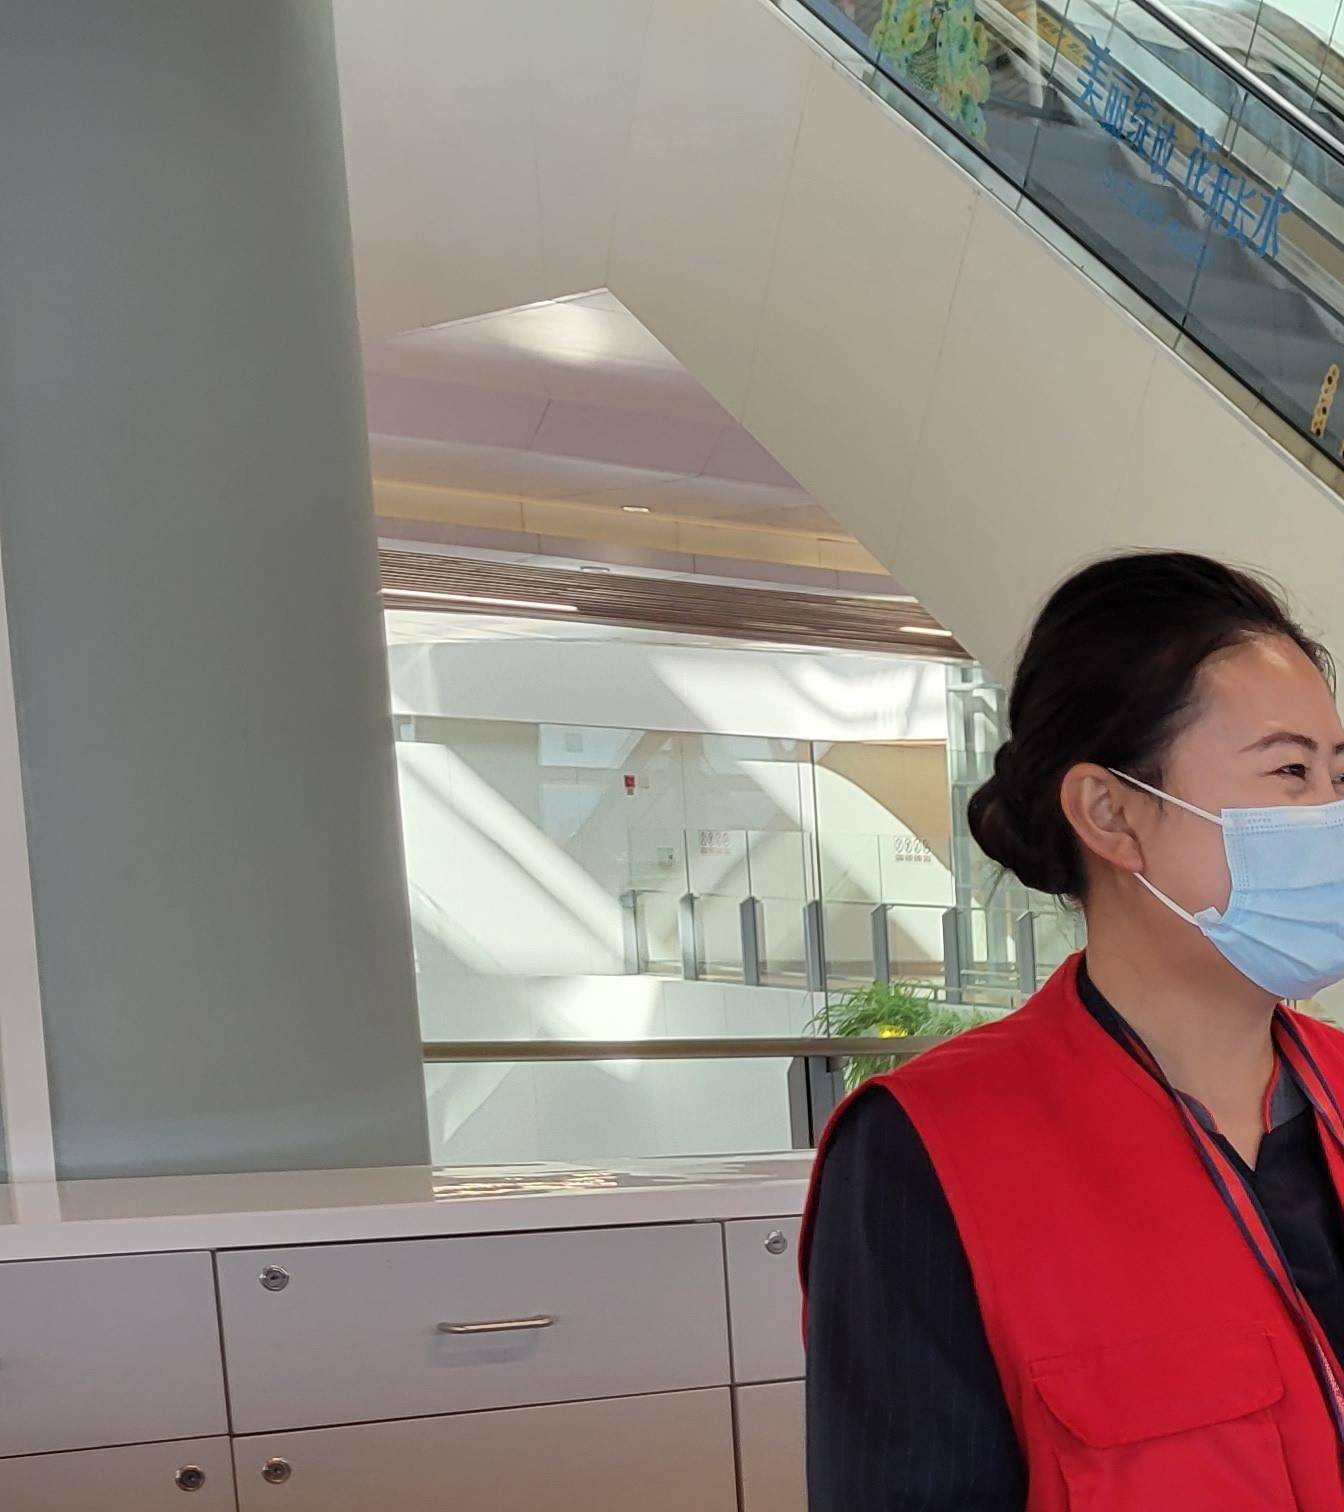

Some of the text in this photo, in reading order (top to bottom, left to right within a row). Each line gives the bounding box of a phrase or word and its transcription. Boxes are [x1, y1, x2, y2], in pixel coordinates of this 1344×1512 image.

[1076, 35, 1178, 176] 美丽绽放
[1185, 127, 1291, 257] 花开长水
